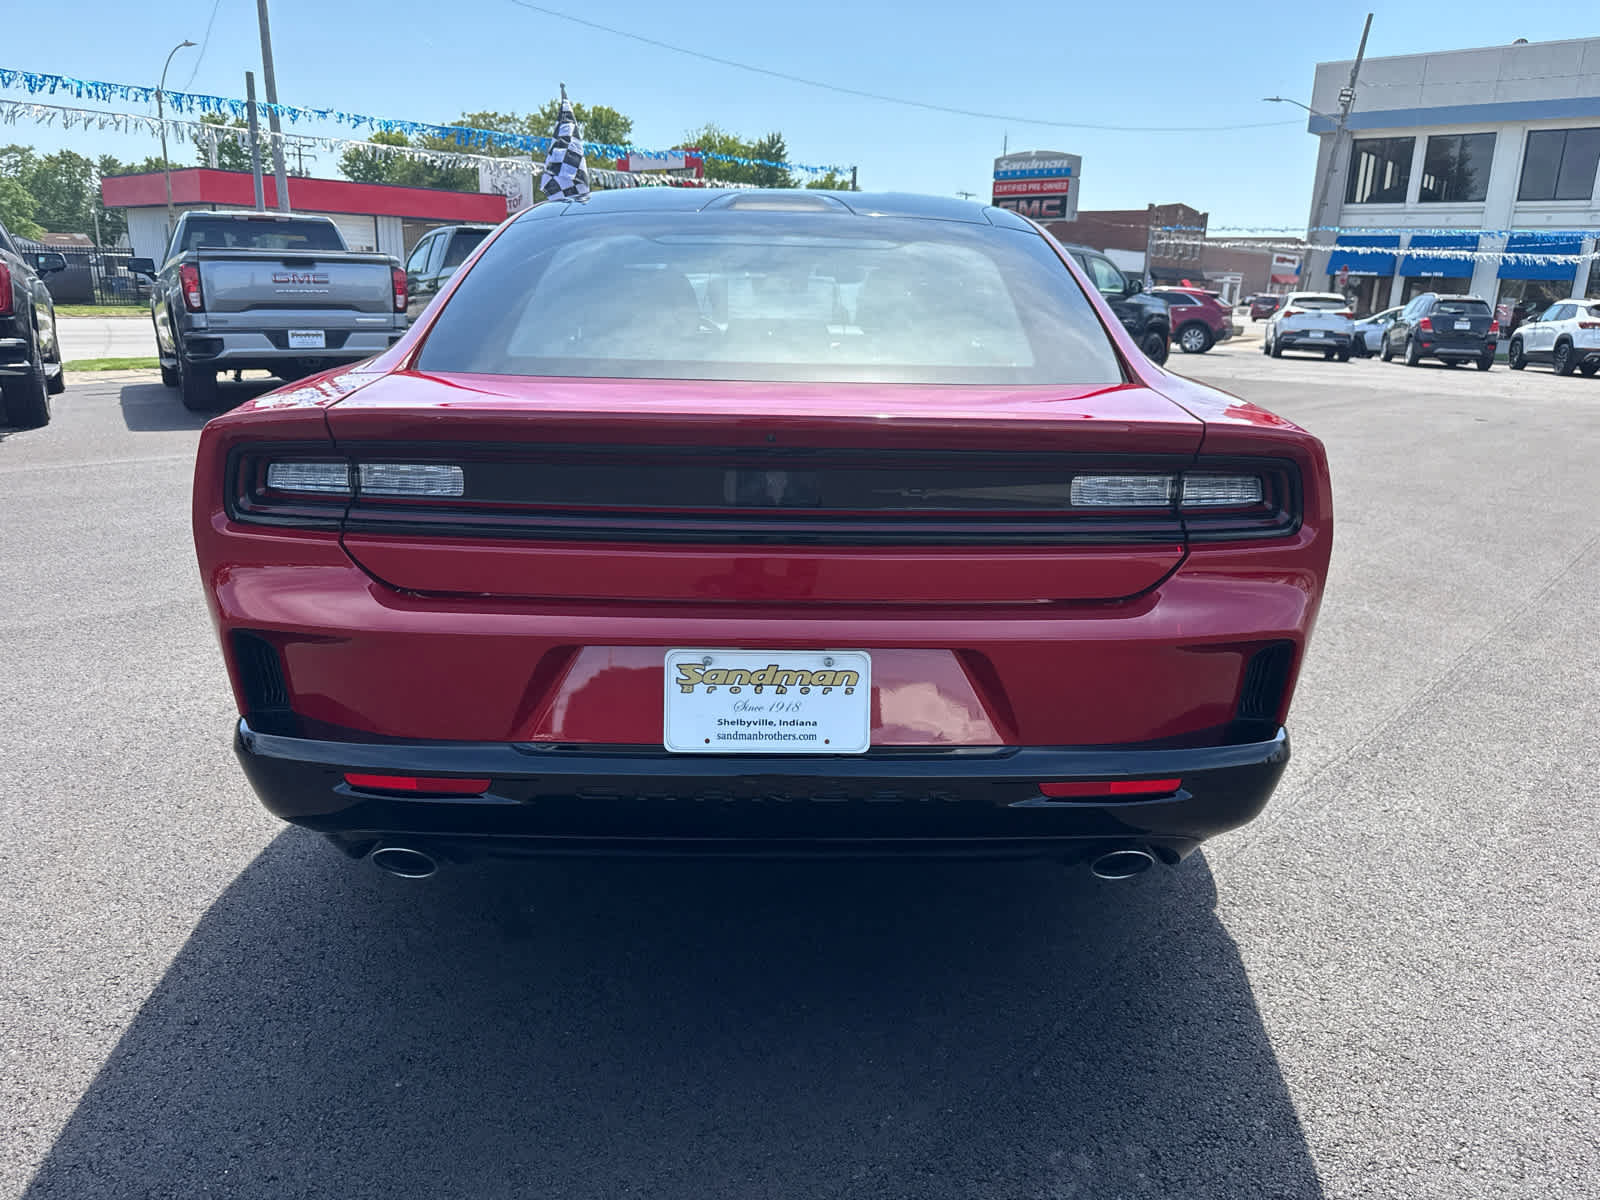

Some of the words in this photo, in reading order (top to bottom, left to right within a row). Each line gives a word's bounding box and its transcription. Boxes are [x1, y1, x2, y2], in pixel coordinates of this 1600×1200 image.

[998, 158, 1068, 171] Sandman
[995, 183, 1027, 192] CERTIFIED
[272, 272, 329, 284] GMC
[676, 664, 859, 686] Sandman
[680, 685, 854, 695] Brothers
[733, 699, 764, 713] Since
[769, 701, 802, 713] 1918
[717, 718, 777, 728] Shelbyville,
[779, 719, 817, 727] Indiana
[717, 731, 817, 741] sandmanbrothers.com
